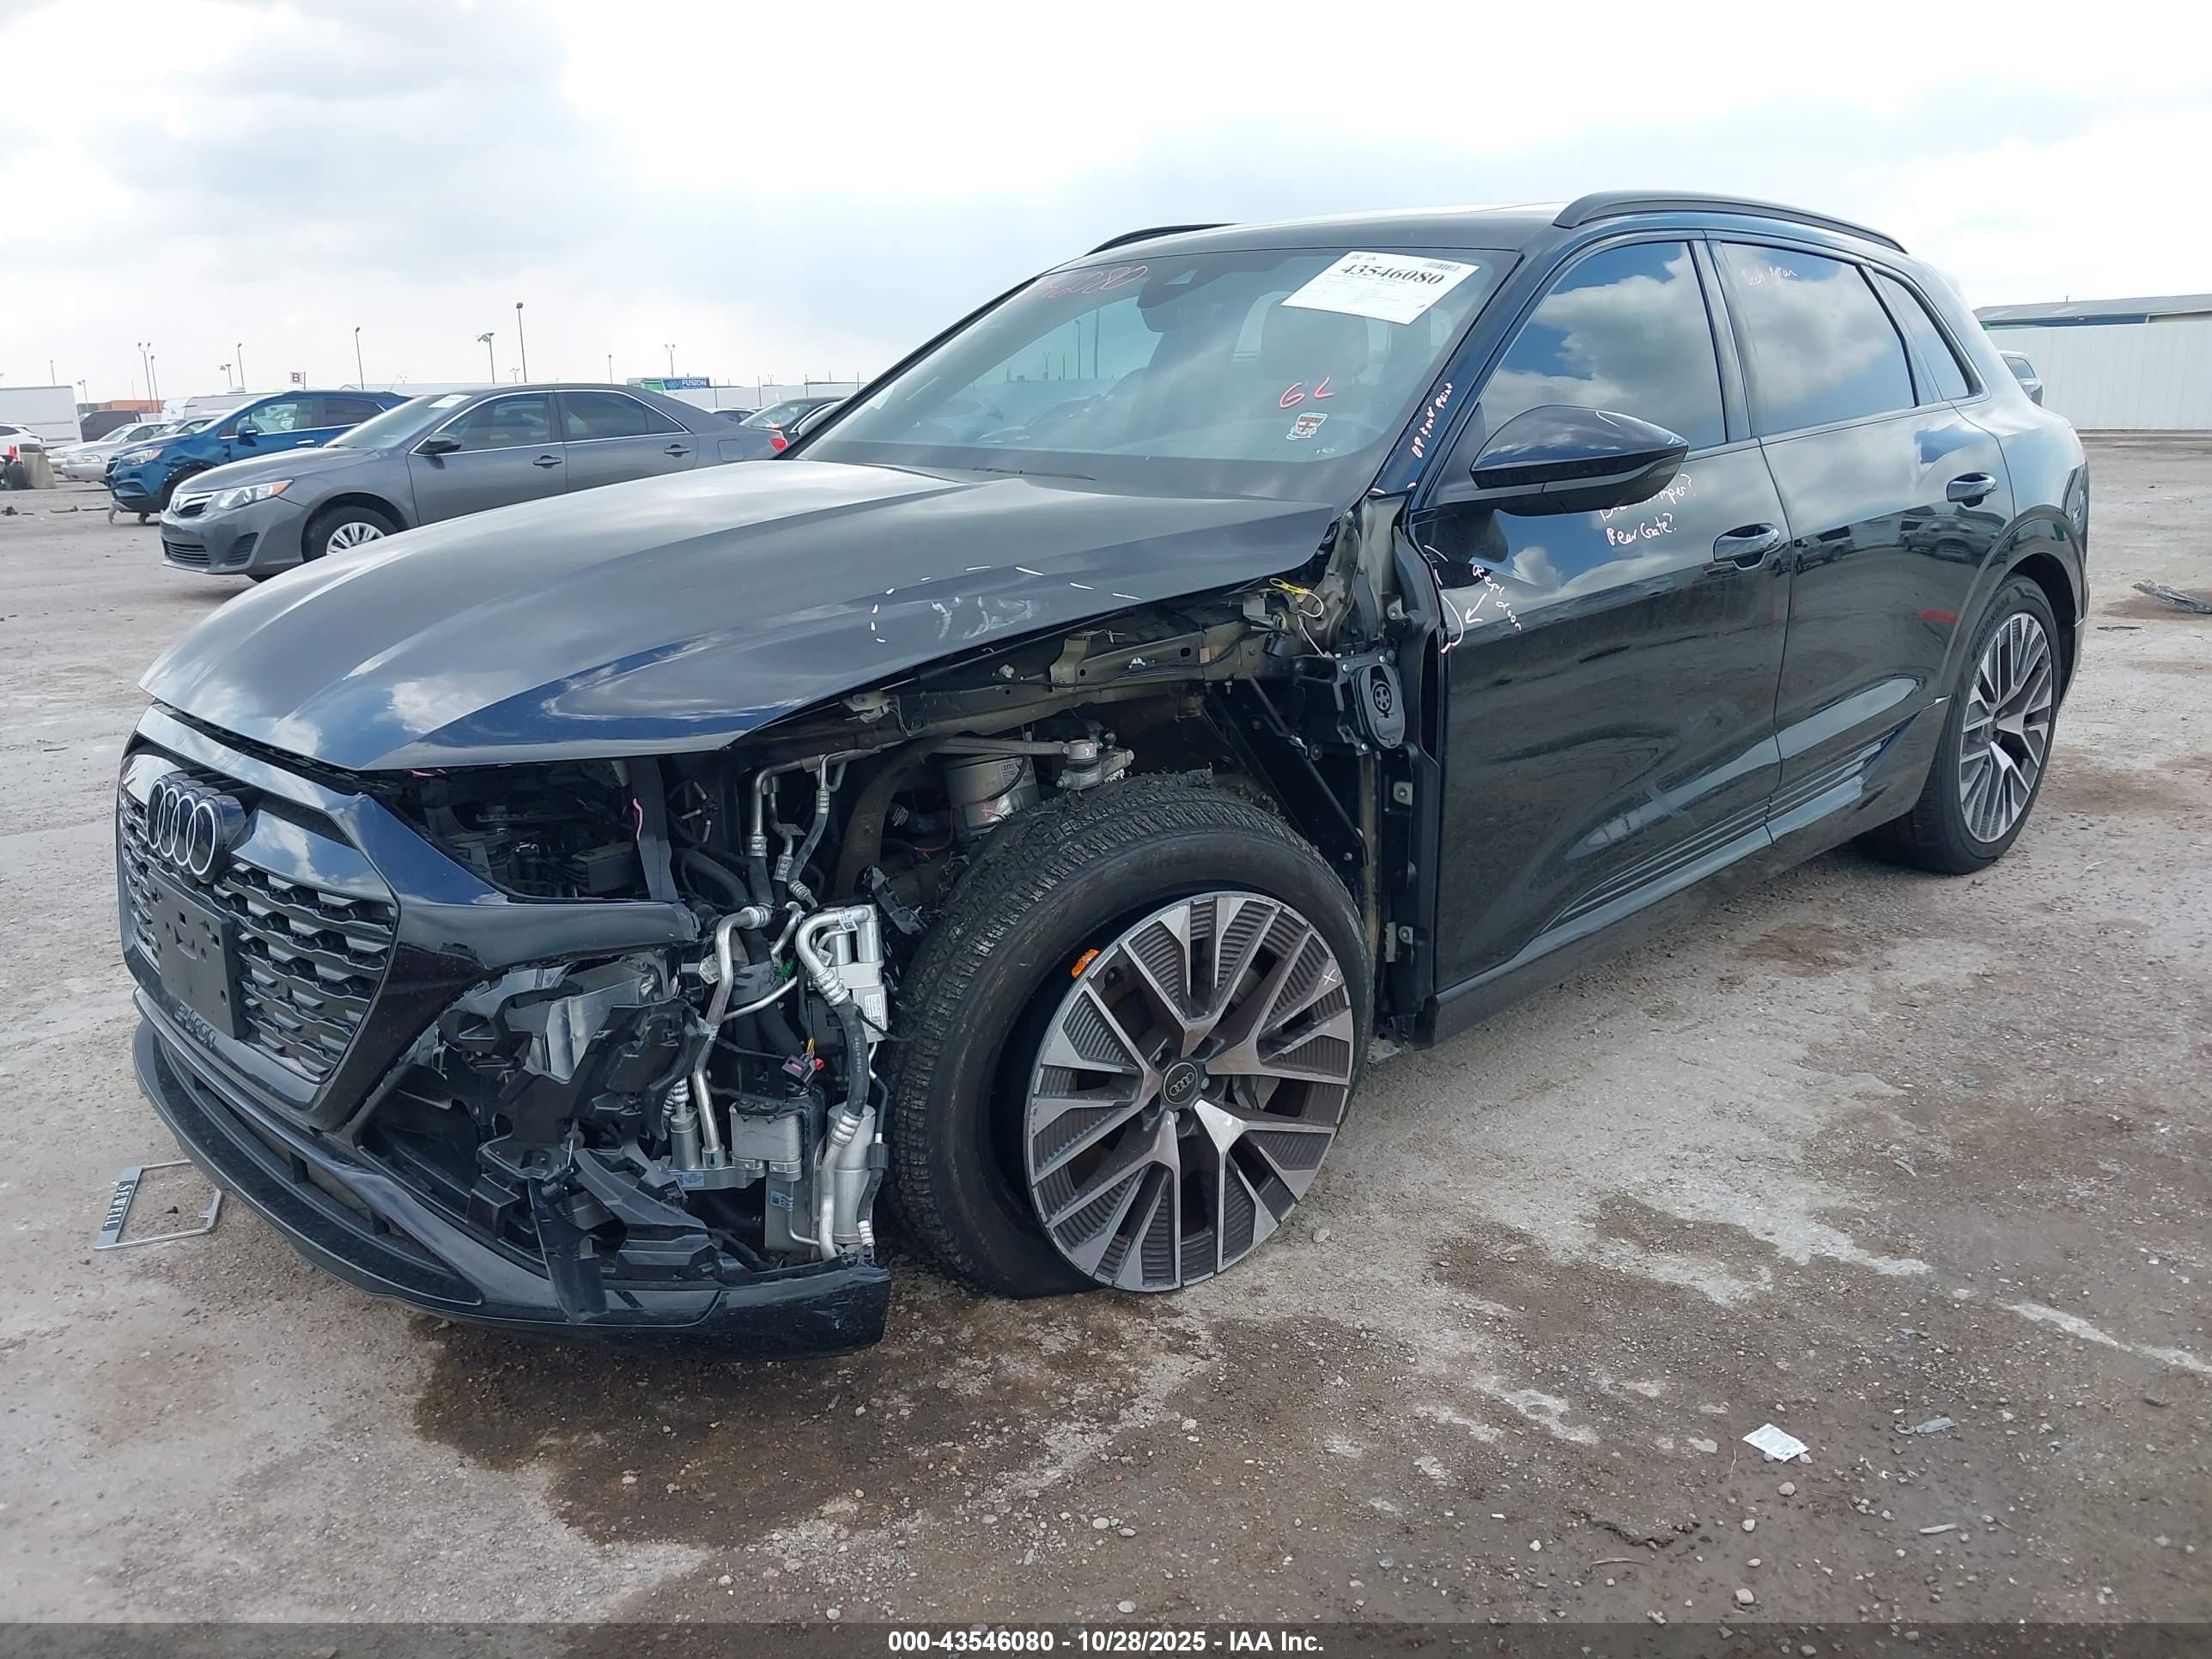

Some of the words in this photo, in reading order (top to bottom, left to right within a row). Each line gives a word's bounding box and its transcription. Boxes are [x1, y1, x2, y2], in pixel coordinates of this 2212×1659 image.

[1340, 264, 1444, 284] 43546080
[292, 373, 301, 383] B
[104, 1184, 134, 1228] SEWELL
